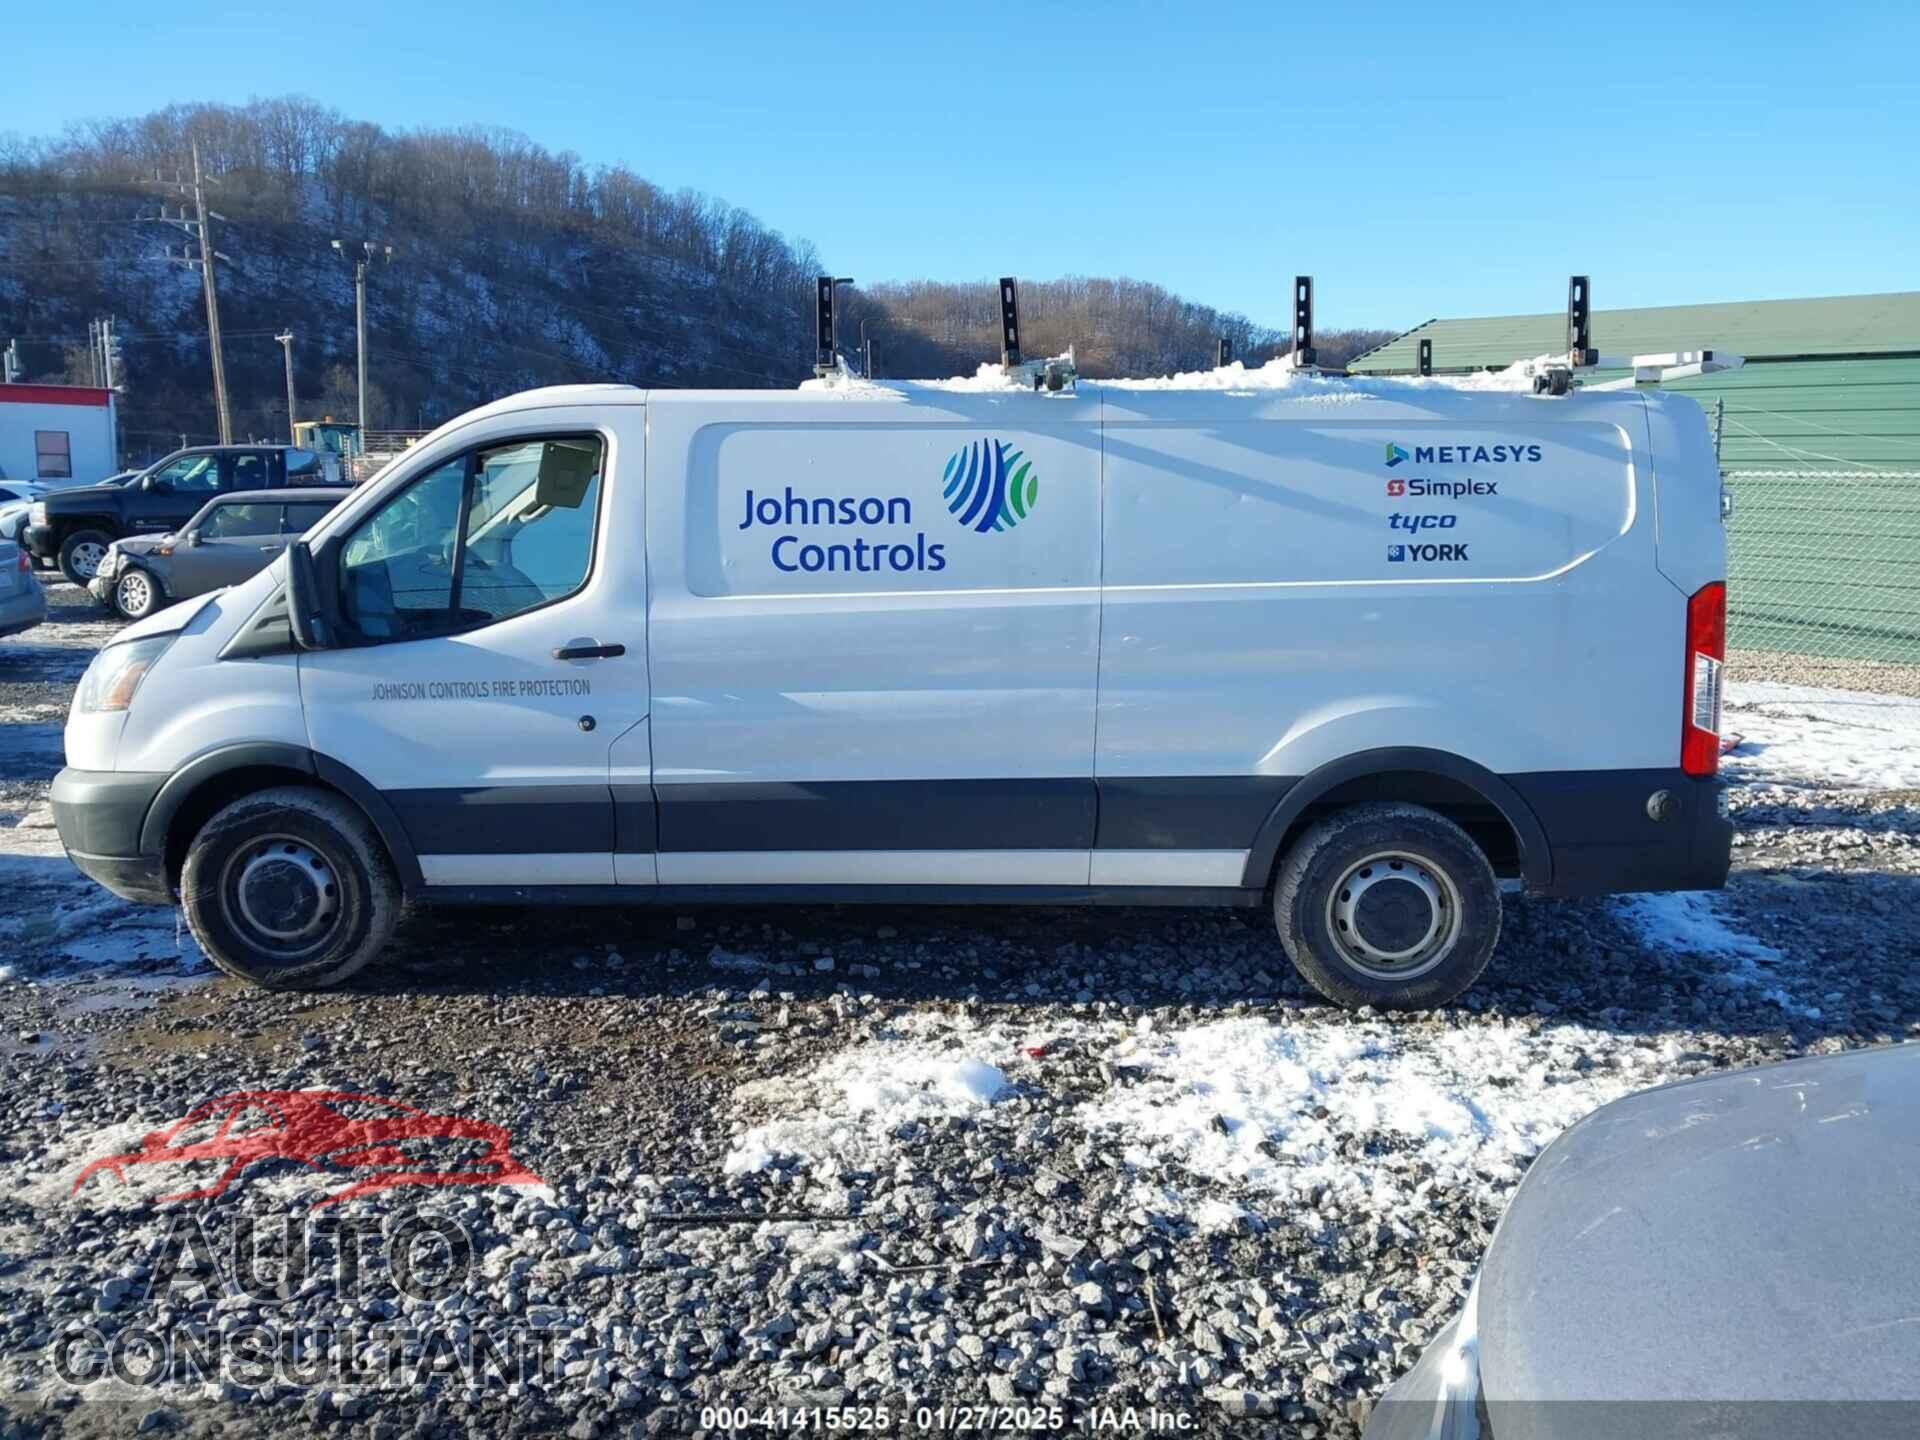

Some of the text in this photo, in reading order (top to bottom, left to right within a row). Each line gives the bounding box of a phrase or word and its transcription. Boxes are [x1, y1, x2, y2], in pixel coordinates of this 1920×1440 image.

[1415, 445, 1542, 463] METASYS
[1408, 478, 1497, 499] Simplex
[739, 487, 911, 530] Johnson
[1388, 512, 1457, 534] tyco
[771, 533, 946, 571] Controls
[1406, 544, 1469, 561] YORK
[372, 679, 591, 700] JOHNSON CONTROLS FIRE PROTECTION
